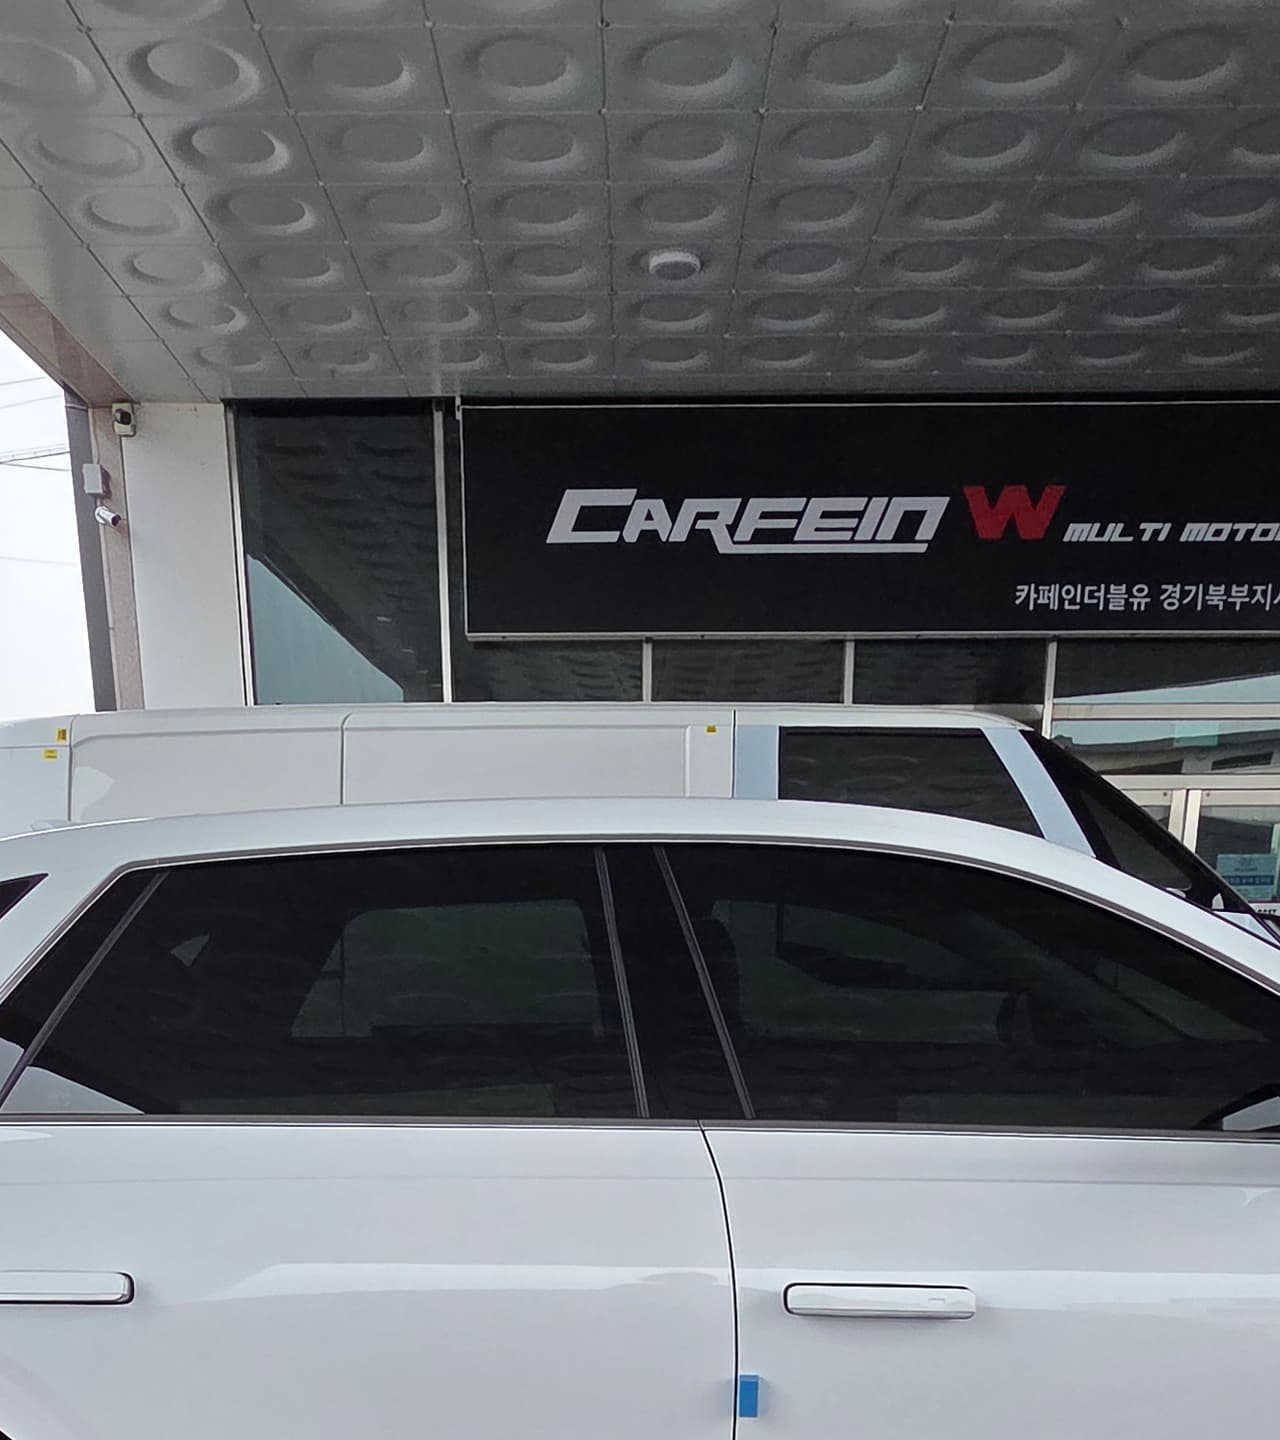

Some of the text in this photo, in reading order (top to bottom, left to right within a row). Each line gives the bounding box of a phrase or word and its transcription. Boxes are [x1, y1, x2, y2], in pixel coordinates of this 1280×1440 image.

[963, 485, 1066, 540] W
[1062, 522, 1171, 542] MULTI
[1014, 583, 1152, 611] 카페인더블유
